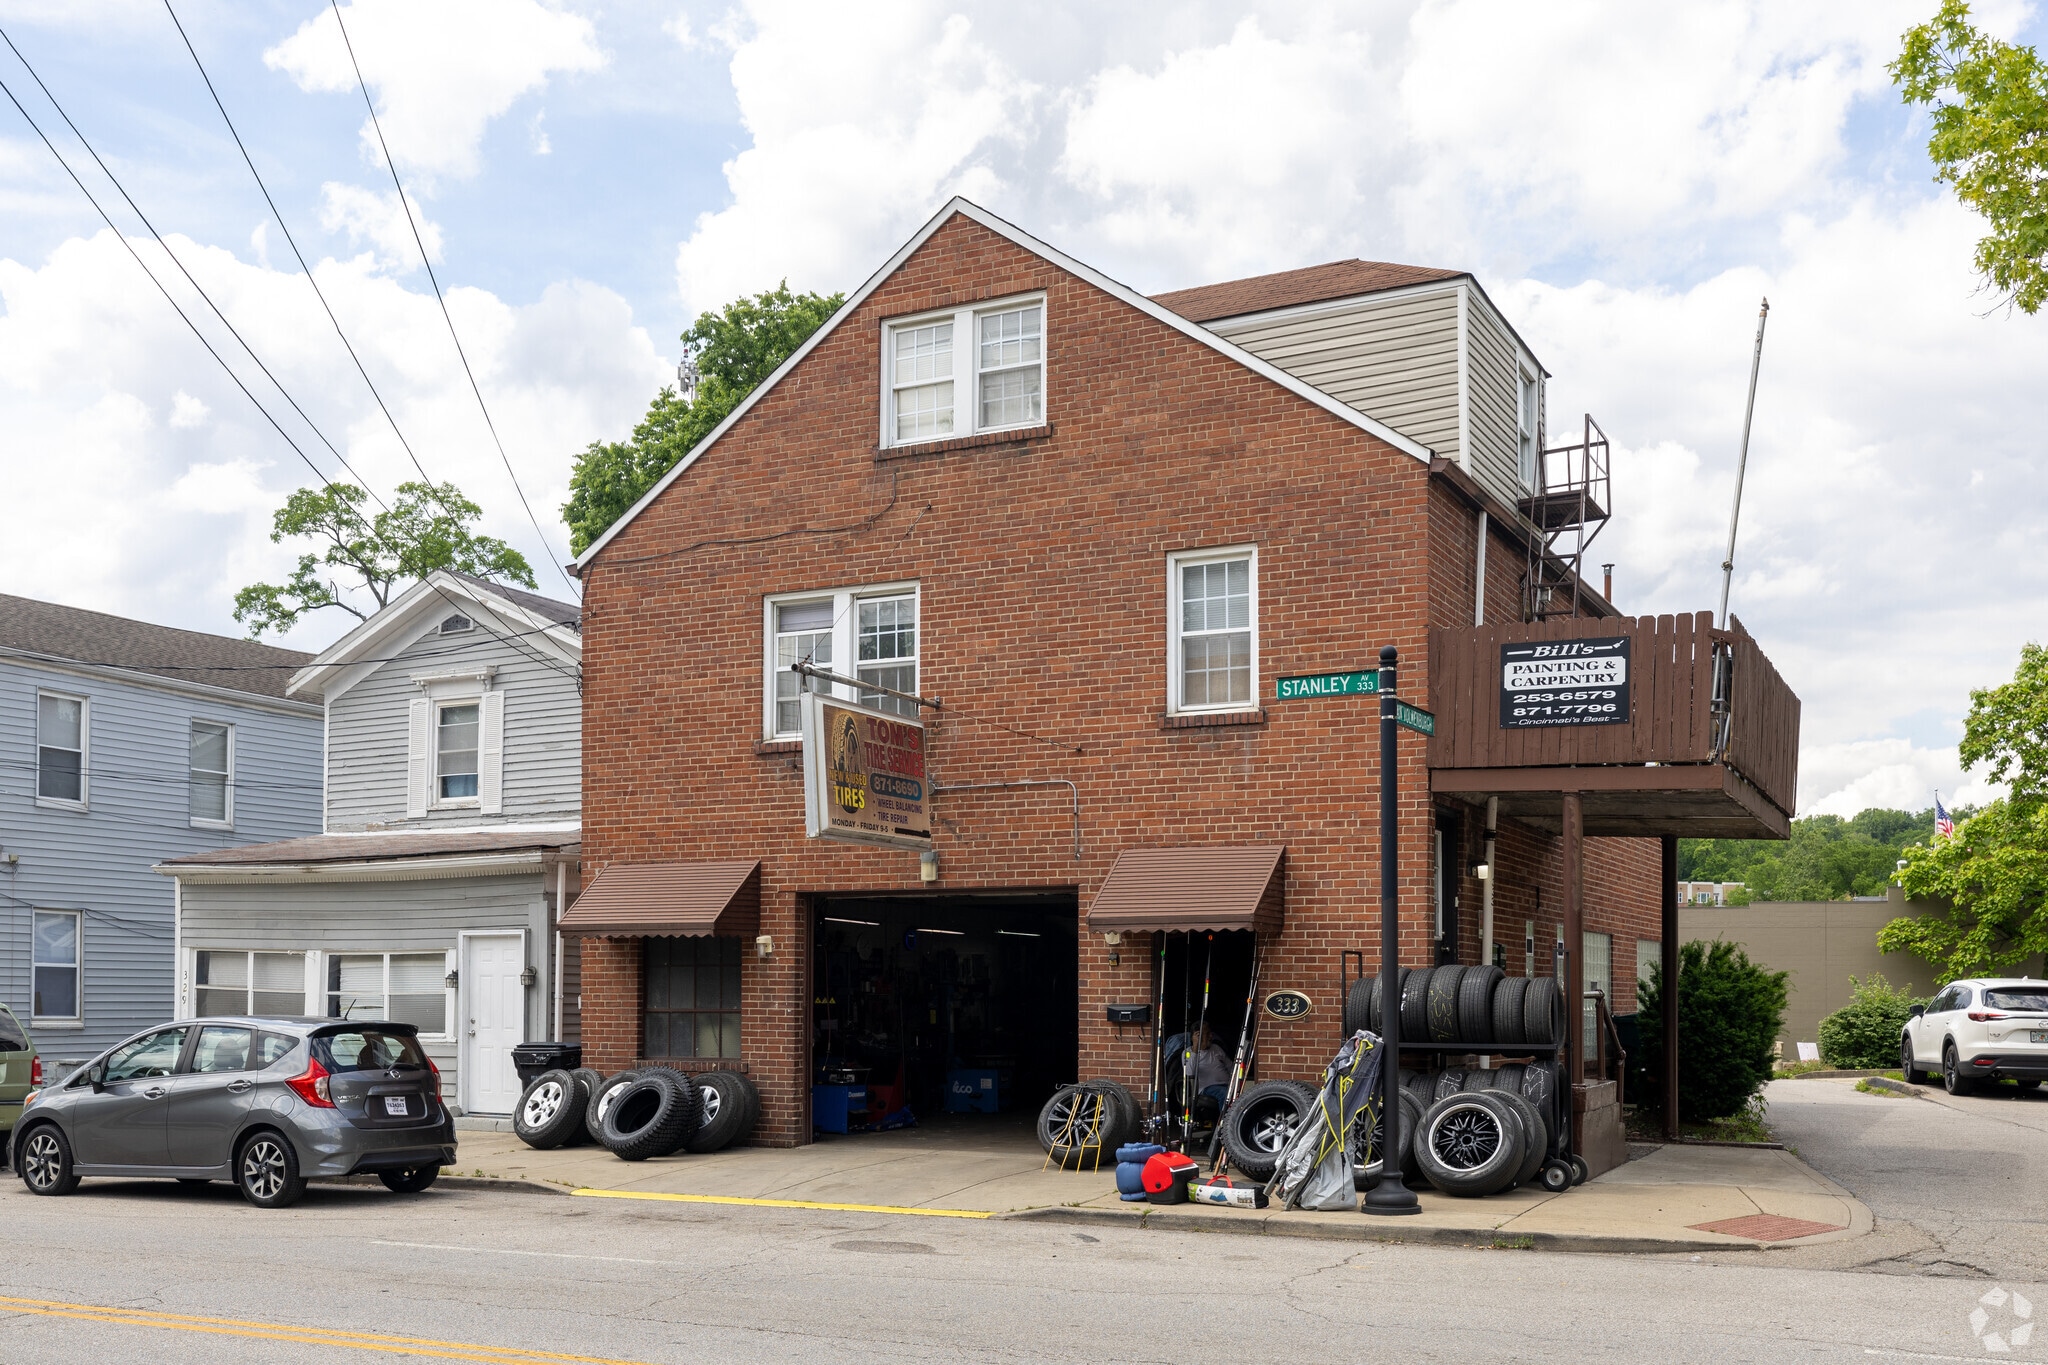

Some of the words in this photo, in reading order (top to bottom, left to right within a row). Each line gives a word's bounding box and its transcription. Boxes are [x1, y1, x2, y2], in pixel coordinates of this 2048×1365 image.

[1532, 643, 1595, 658] Bill's
[1512, 660, 1600, 675] PAINTING
[1604, 660, 1616, 670] &
[1360, 674, 1369, 682] AV
[1511, 672, 1618, 687] CARPENTRY
[1282, 675, 1351, 697] STANLEY
[1356, 681, 1374, 691] 333
[1513, 690, 1617, 704] 253-6579
[1512, 703, 1617, 716] 871-7796
[1518, 716, 1580, 726] Cincinnati's
[1582, 715, 1611, 723] Best
[866, 717, 919, 750] TOM'S
[864, 742, 886, 770] TIRE
[887, 747, 924, 778] SERVICE
[829, 768, 844, 784] NEW
[851, 772, 867, 787] USED
[874, 778, 918, 796] 871-8690
[833, 785, 865, 809] TIRES
[877, 798, 895, 811] WHEEL
[896, 801, 922, 814] BALANCING
[832, 818, 856, 829] MONDAY
[860, 821, 879, 832] FRIDAY
[880, 824, 889, 833] 9-5
[877, 812, 890, 823] TIRE
[890, 813, 908, 825] REPAIR
[1273, 996, 1300, 1014] 333
